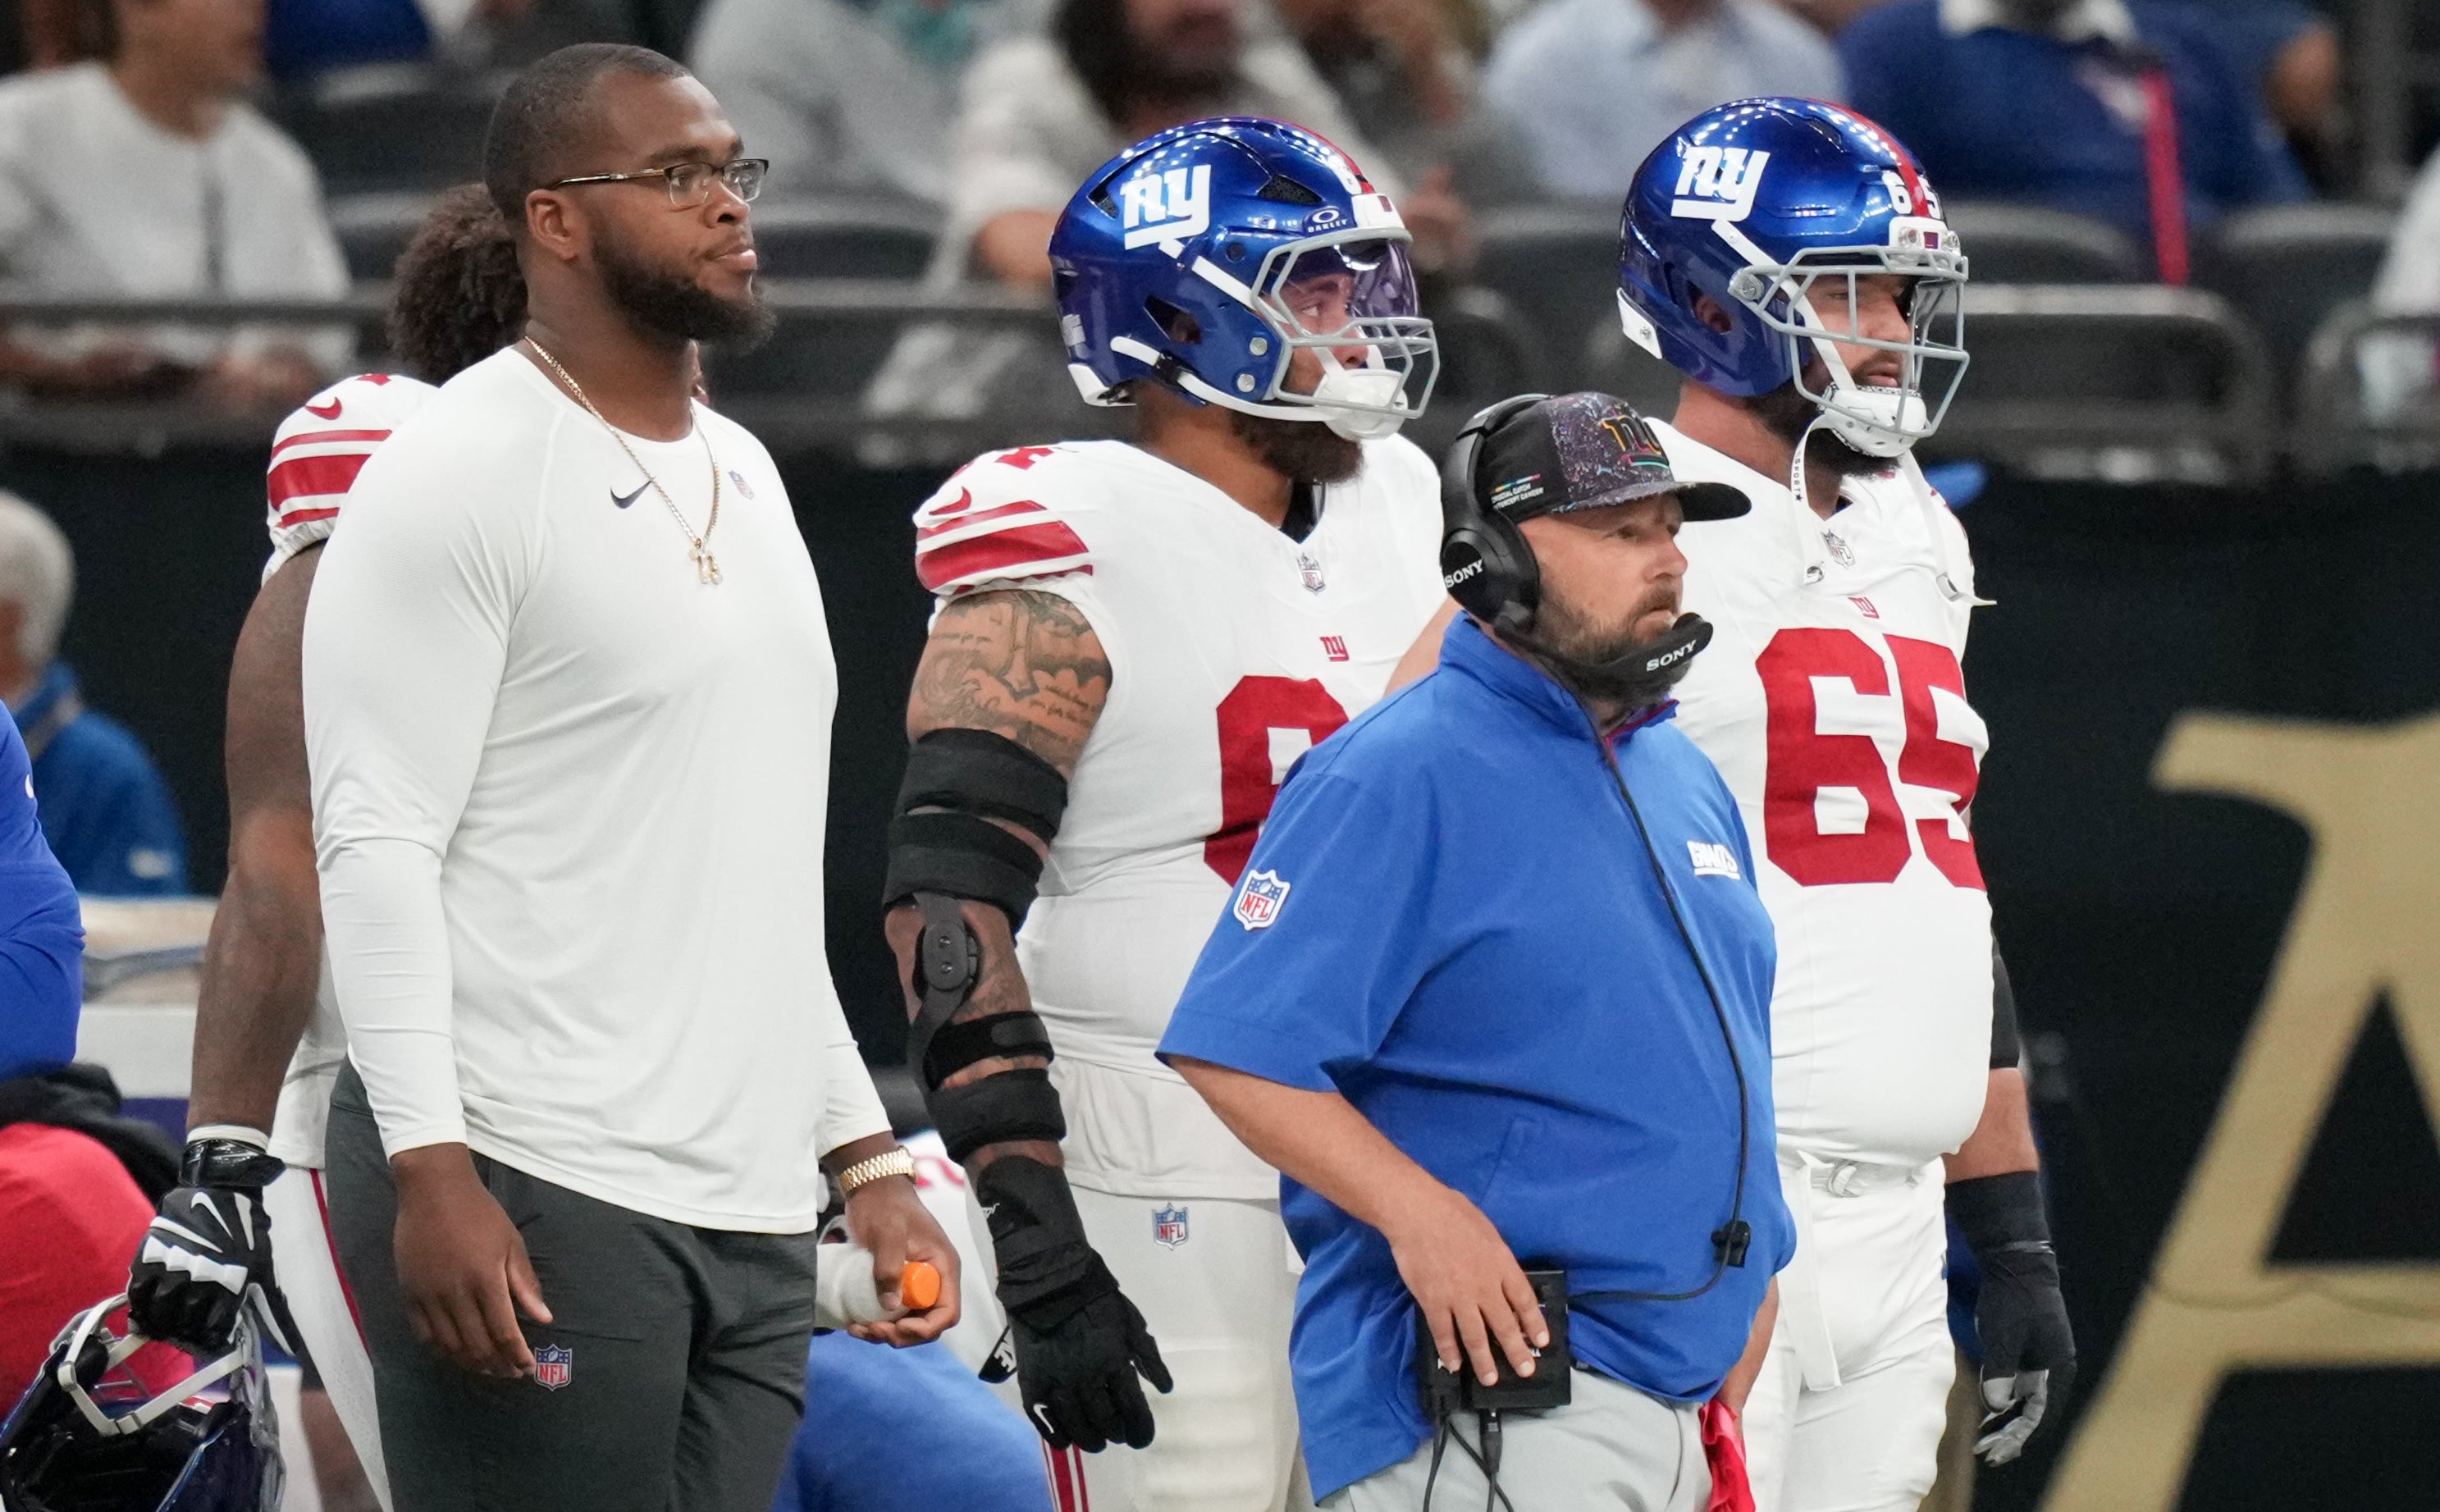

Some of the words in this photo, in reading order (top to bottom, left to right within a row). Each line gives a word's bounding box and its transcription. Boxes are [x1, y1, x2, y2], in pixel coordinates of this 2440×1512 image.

[1881, 171, 1942, 220] 65
[1308, 218, 1348, 233] OAKLEY
[1444, 559, 1483, 588] SONY
[1646, 639, 1697, 672] SONY
[1755, 627, 1988, 888] 65
[1240, 892, 1271, 919] NFL
[1158, 1222, 1185, 1241] NFL
[538, 1364, 568, 1385] NFL
